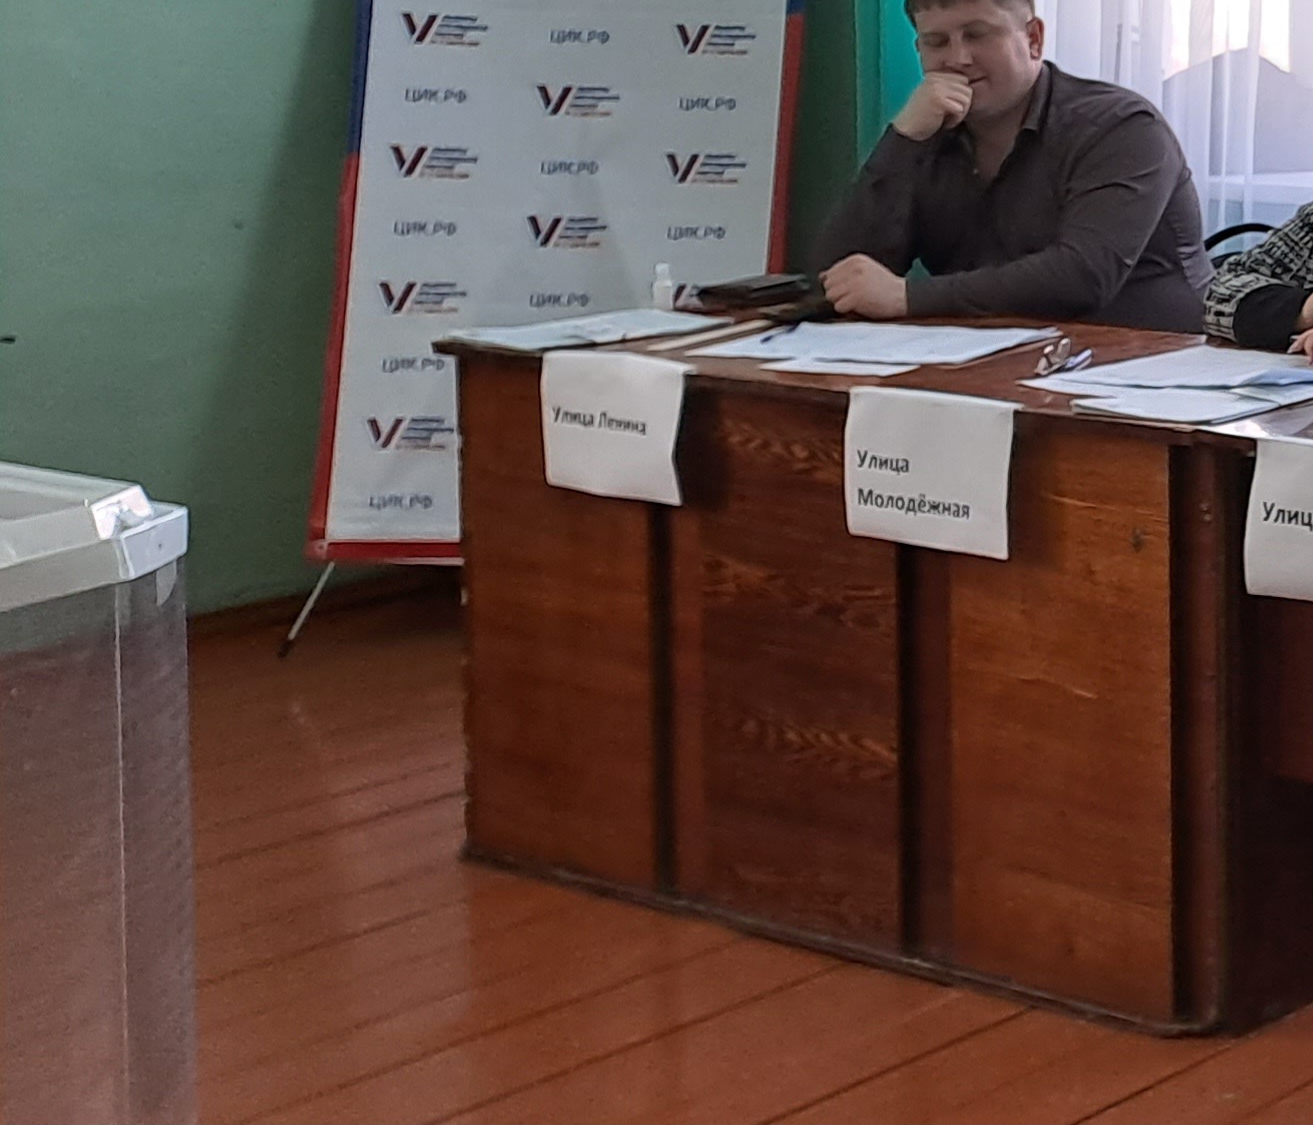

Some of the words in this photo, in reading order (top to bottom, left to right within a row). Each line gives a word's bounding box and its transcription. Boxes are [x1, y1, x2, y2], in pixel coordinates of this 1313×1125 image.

[552, 406, 594, 428] Улица
[598, 411, 647, 436] Ленина
[856, 450, 910, 475] Улица
[857, 487, 970, 519] Молодёжная
